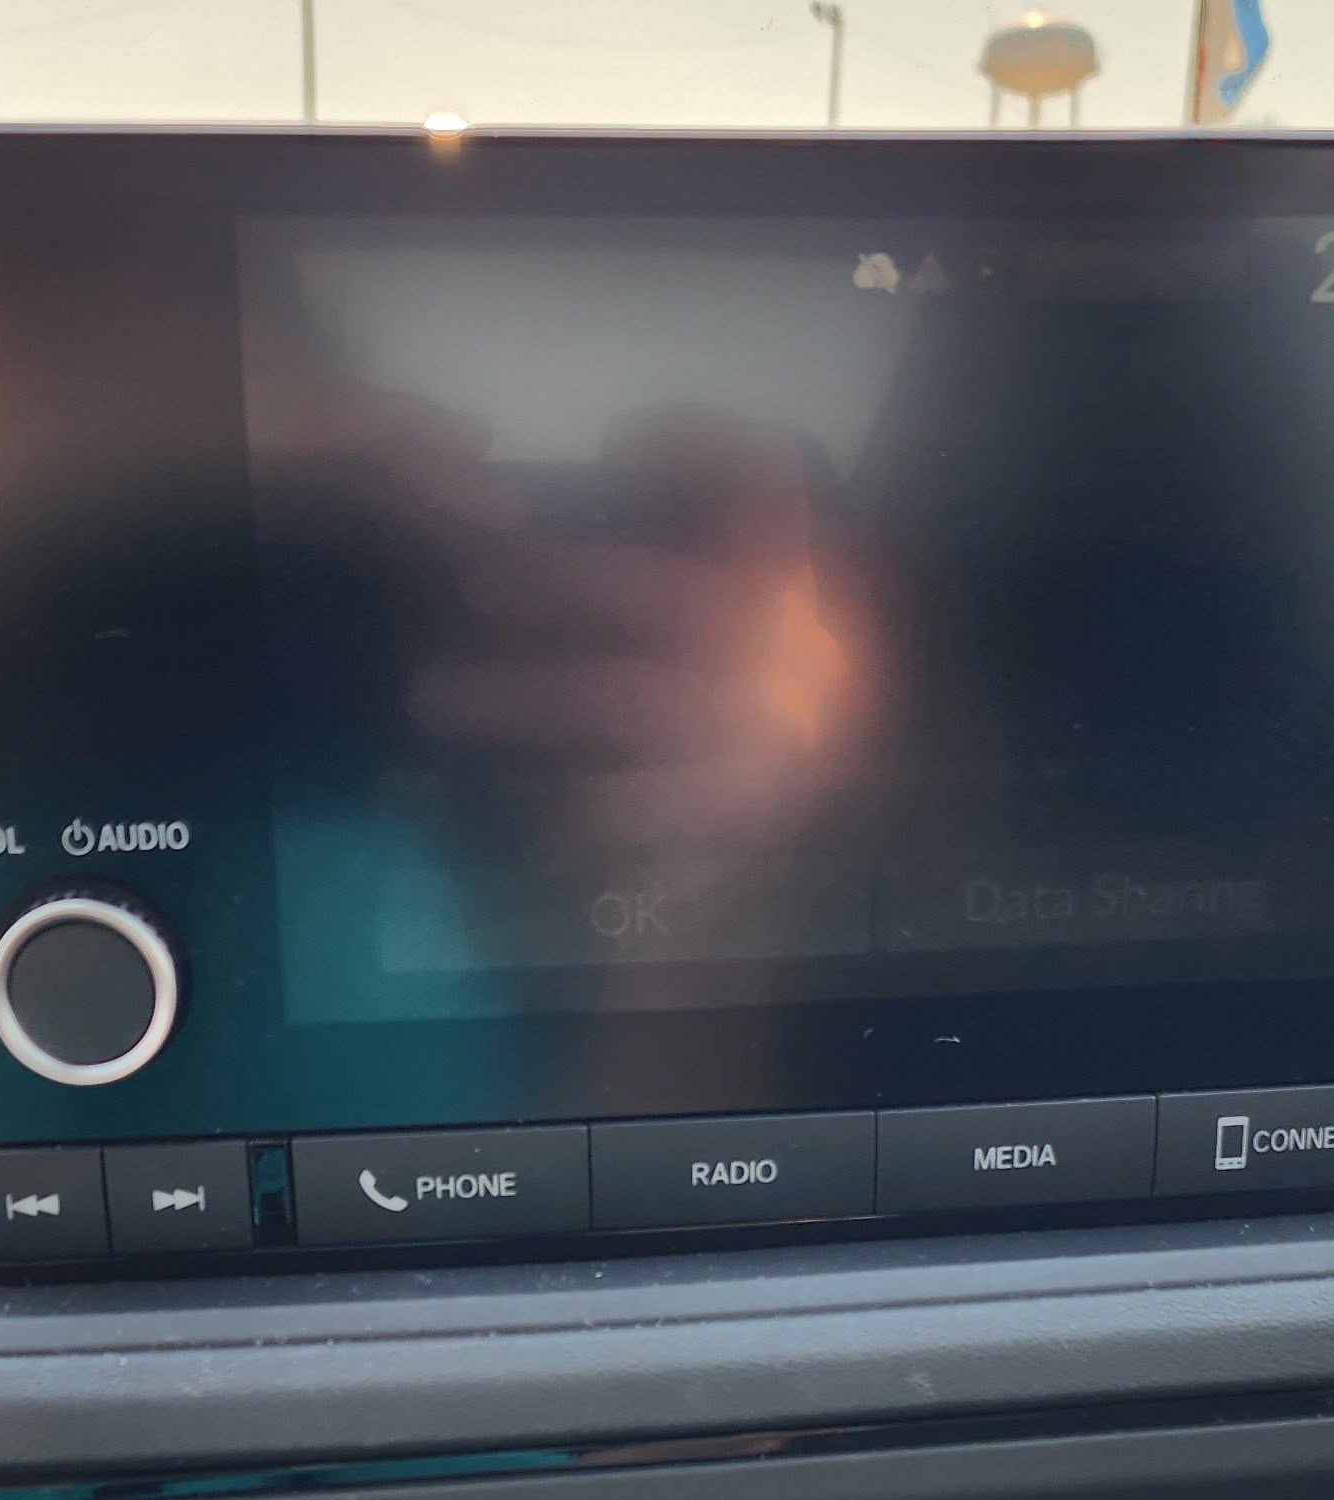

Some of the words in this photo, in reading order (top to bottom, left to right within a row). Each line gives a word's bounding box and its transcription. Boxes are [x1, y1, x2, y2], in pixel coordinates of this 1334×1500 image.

[97, 821, 190, 853] AUDIO
[964, 878, 1075, 924] Data
[1091, 869, 1269, 922] Sharing
[589, 890, 667, 938] OK
[690, 1159, 778, 1187] RADIO
[973, 1143, 1058, 1172] MEDIA
[415, 1171, 518, 1201] PHONE
